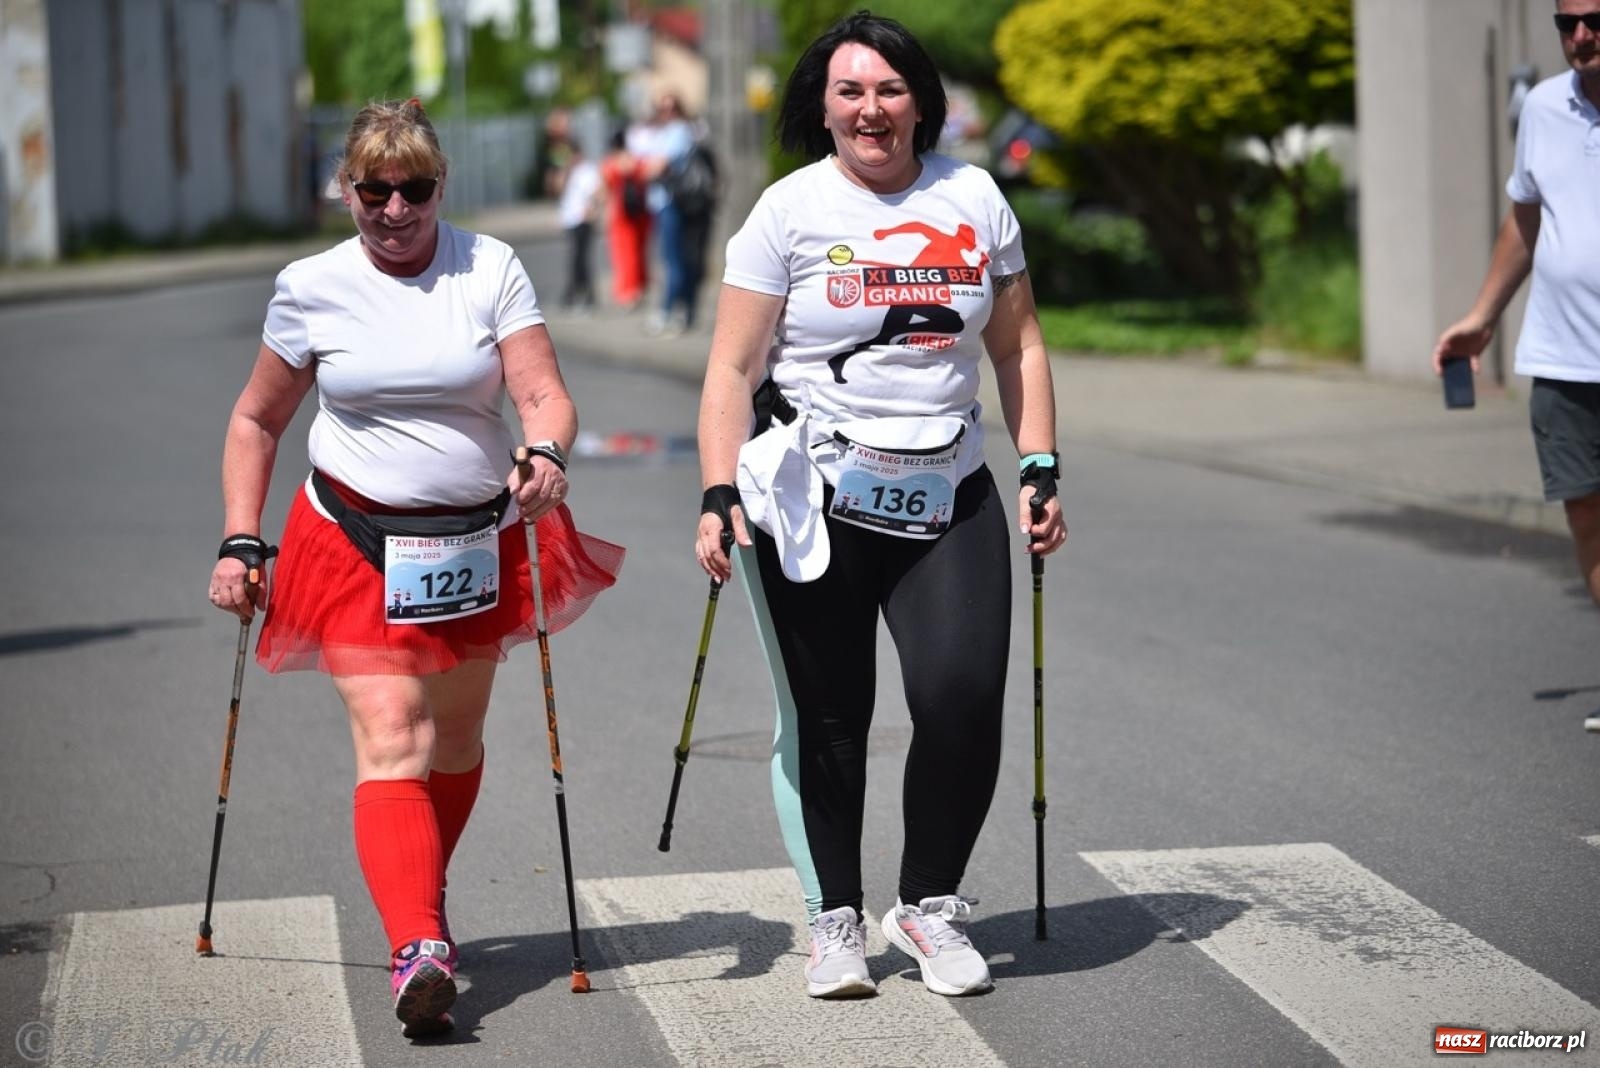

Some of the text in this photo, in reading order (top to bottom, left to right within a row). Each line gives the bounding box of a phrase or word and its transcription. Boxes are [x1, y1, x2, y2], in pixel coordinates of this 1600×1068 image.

[868, 268, 981, 284] XI BIEG BEZ
[868, 287, 950, 303] GRANIC
[856, 447, 952, 466] XVII BIEG BEZ GRANIC
[859, 462, 879, 472] maja
[880, 467, 899, 476] 2025
[871, 486, 928, 517] 136
[395, 539, 415, 548] XVII
[417, 539, 441, 548] BIEG
[443, 537, 462, 547] BEZ
[464, 528, 493, 545] GRANIC
[400, 552, 421, 560] maja
[420, 567, 473, 599] 122
